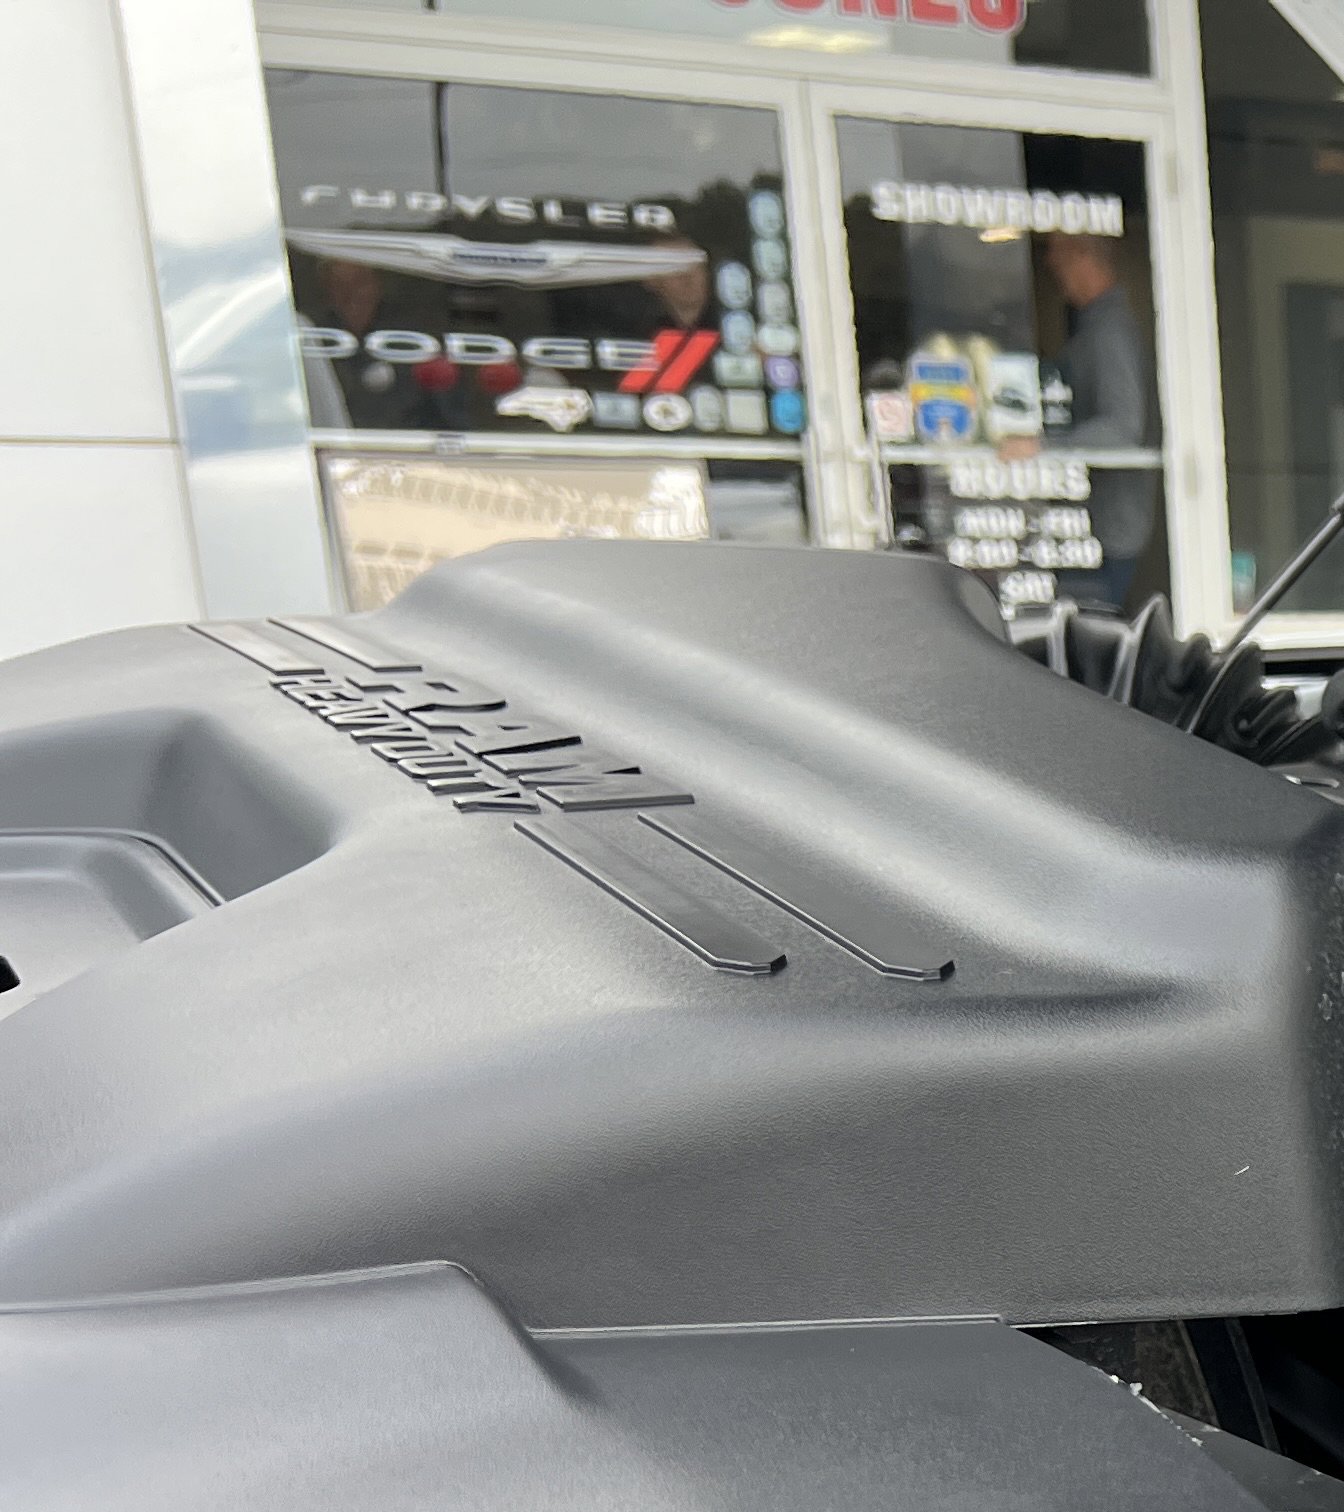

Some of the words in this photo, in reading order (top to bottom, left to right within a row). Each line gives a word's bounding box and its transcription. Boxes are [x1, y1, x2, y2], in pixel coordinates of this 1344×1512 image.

[871, 180, 1124, 238] SHOWROOM
[294, 325, 661, 374] DODGE
[269, 677, 428, 746] HEAVY
[370, 741, 541, 814] DUTY
[346, 676, 696, 813] RAM
